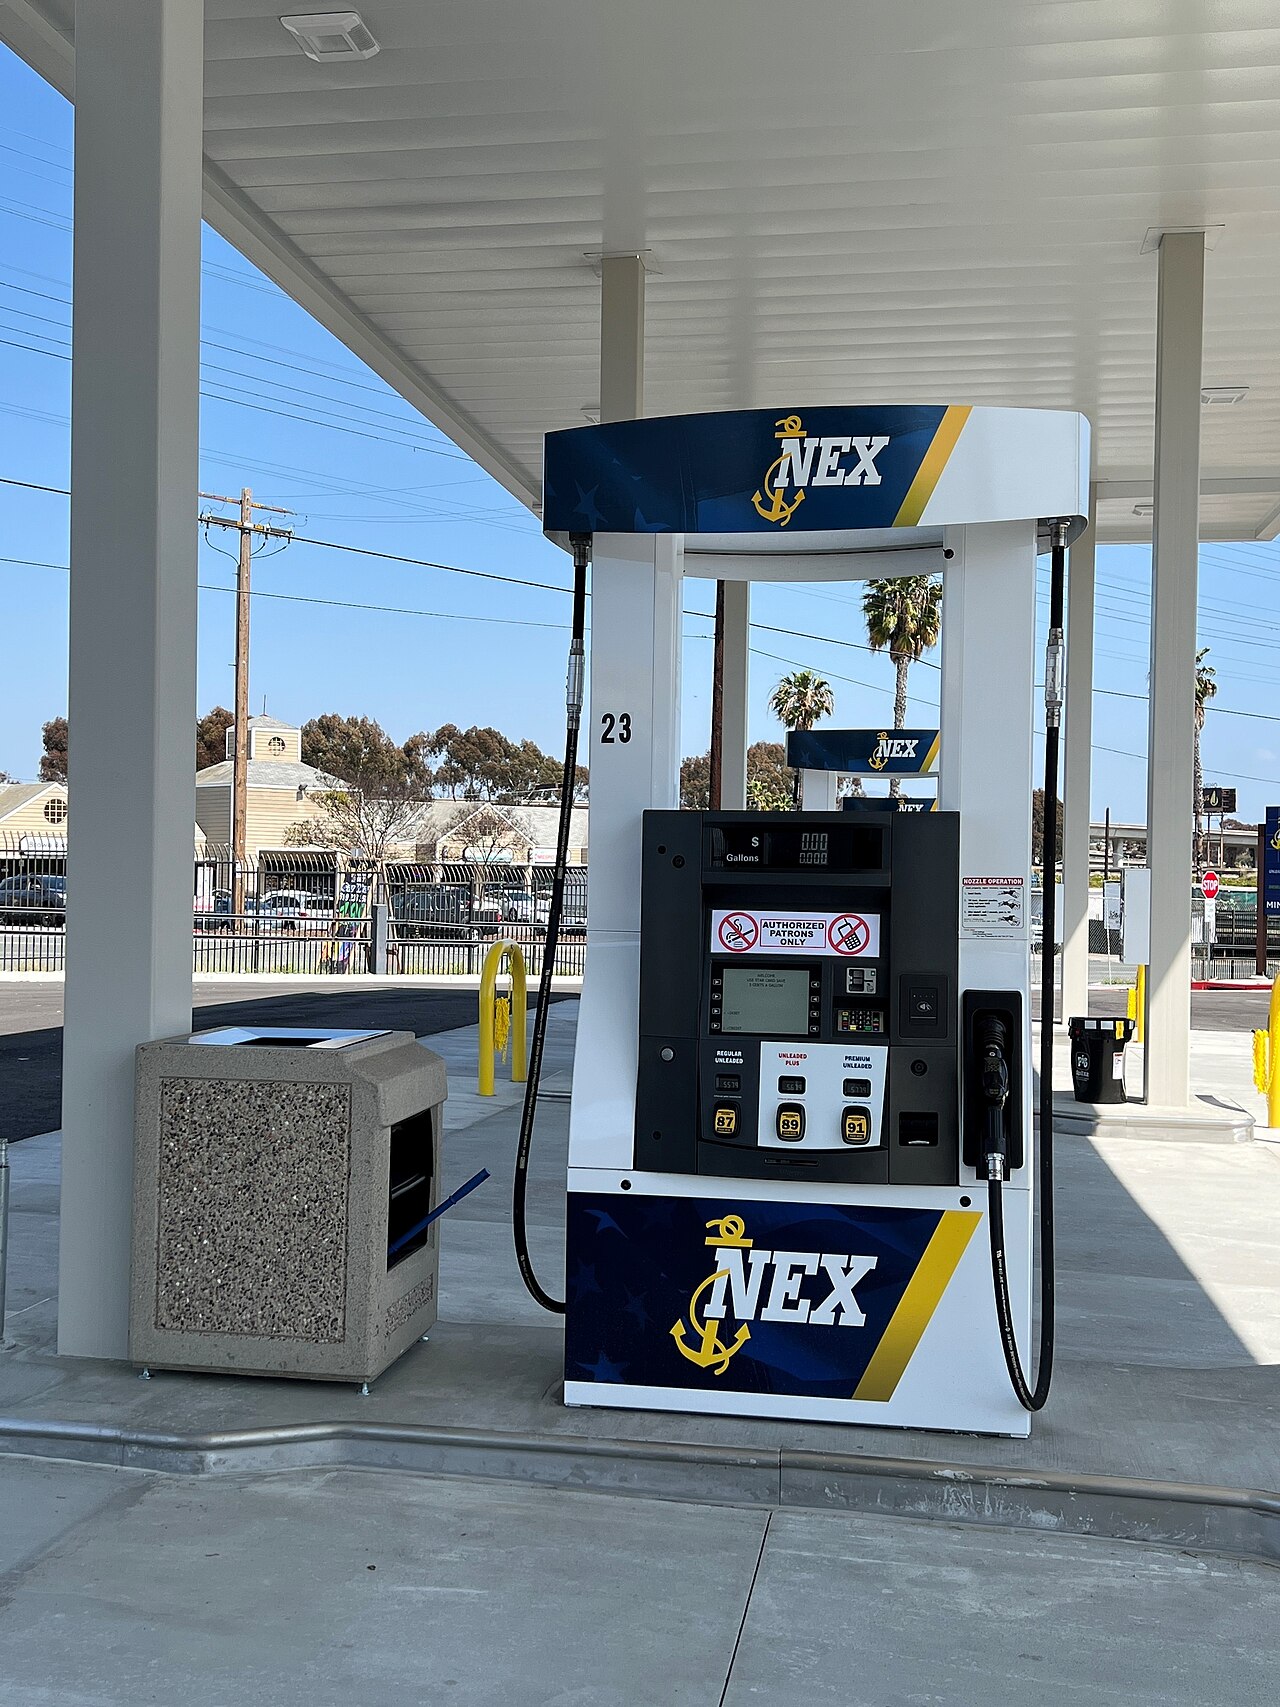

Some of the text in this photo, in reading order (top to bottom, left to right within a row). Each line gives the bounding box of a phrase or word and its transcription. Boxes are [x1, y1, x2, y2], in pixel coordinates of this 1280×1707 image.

[773, 435, 890, 487] NEX
[600, 712, 632, 744] 23
[876, 739, 919, 758] NEX
[751, 836, 759, 848] $
[726, 853, 759, 862] Gallons
[1203, 879, 1218, 891] STOP
[762, 921, 825, 930] AUTHORIZED
[769, 929, 814, 938] PATRONS
[779, 938, 806, 947] ONLY
[716, 1116, 734, 1127] 87
[781, 1119, 799, 1130] 89
[847, 1122, 865, 1133] 91
[703, 1247, 878, 1327] NEX
